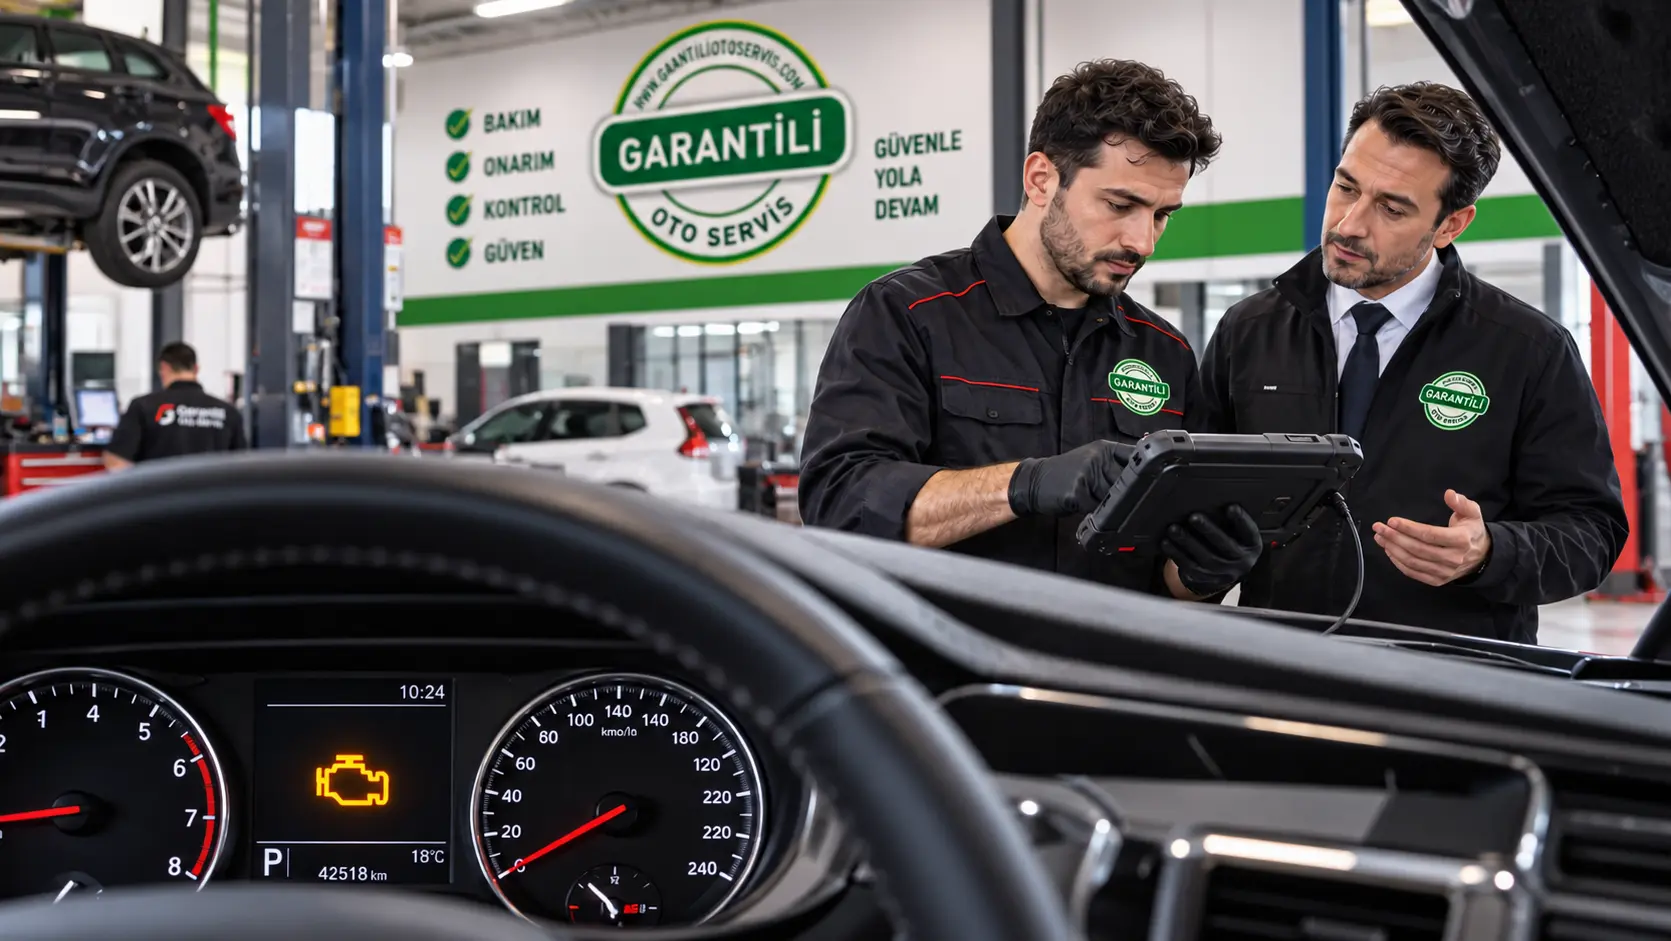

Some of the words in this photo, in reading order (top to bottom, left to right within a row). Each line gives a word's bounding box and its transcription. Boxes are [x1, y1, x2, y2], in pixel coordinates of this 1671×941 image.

[484, 108, 541, 133] BAKIM
[618, 108, 822, 172] GARANTİLİ
[874, 129, 962, 159] GÜVENLE
[483, 150, 555, 177] ONARIM
[874, 165, 922, 189] YOLA
[483, 193, 566, 220] KONTROL
[875, 193, 939, 220] DEVAM
[651, 207, 697, 243] OTO
[707, 196, 794, 247] SERVİS
[484, 237, 544, 264] GÜVEN
[400, 684, 446, 699] 10:24
[86, 704, 101, 723] 4
[567, 713, 594, 727] 100
[604, 704, 632, 718] 140
[641, 713, 669, 727] 140
[138, 722, 151, 741] 5
[672, 731, 699, 745] 180
[173, 759, 186, 777] 6
[515, 756, 536, 772] 60
[693, 757, 721, 773] 120
[501, 788, 522, 804] 40
[702, 789, 732, 805] 220
[184, 809, 198, 827] 7
[501, 824, 522, 840] 20
[702, 824, 732, 840] 220
[263, 848, 283, 877] P
[411, 849, 445, 863] 18°C
[167, 857, 181, 876] 8
[318, 866, 368, 881] 42518
[370, 870, 388, 881] km
[687, 860, 718, 877] 240
